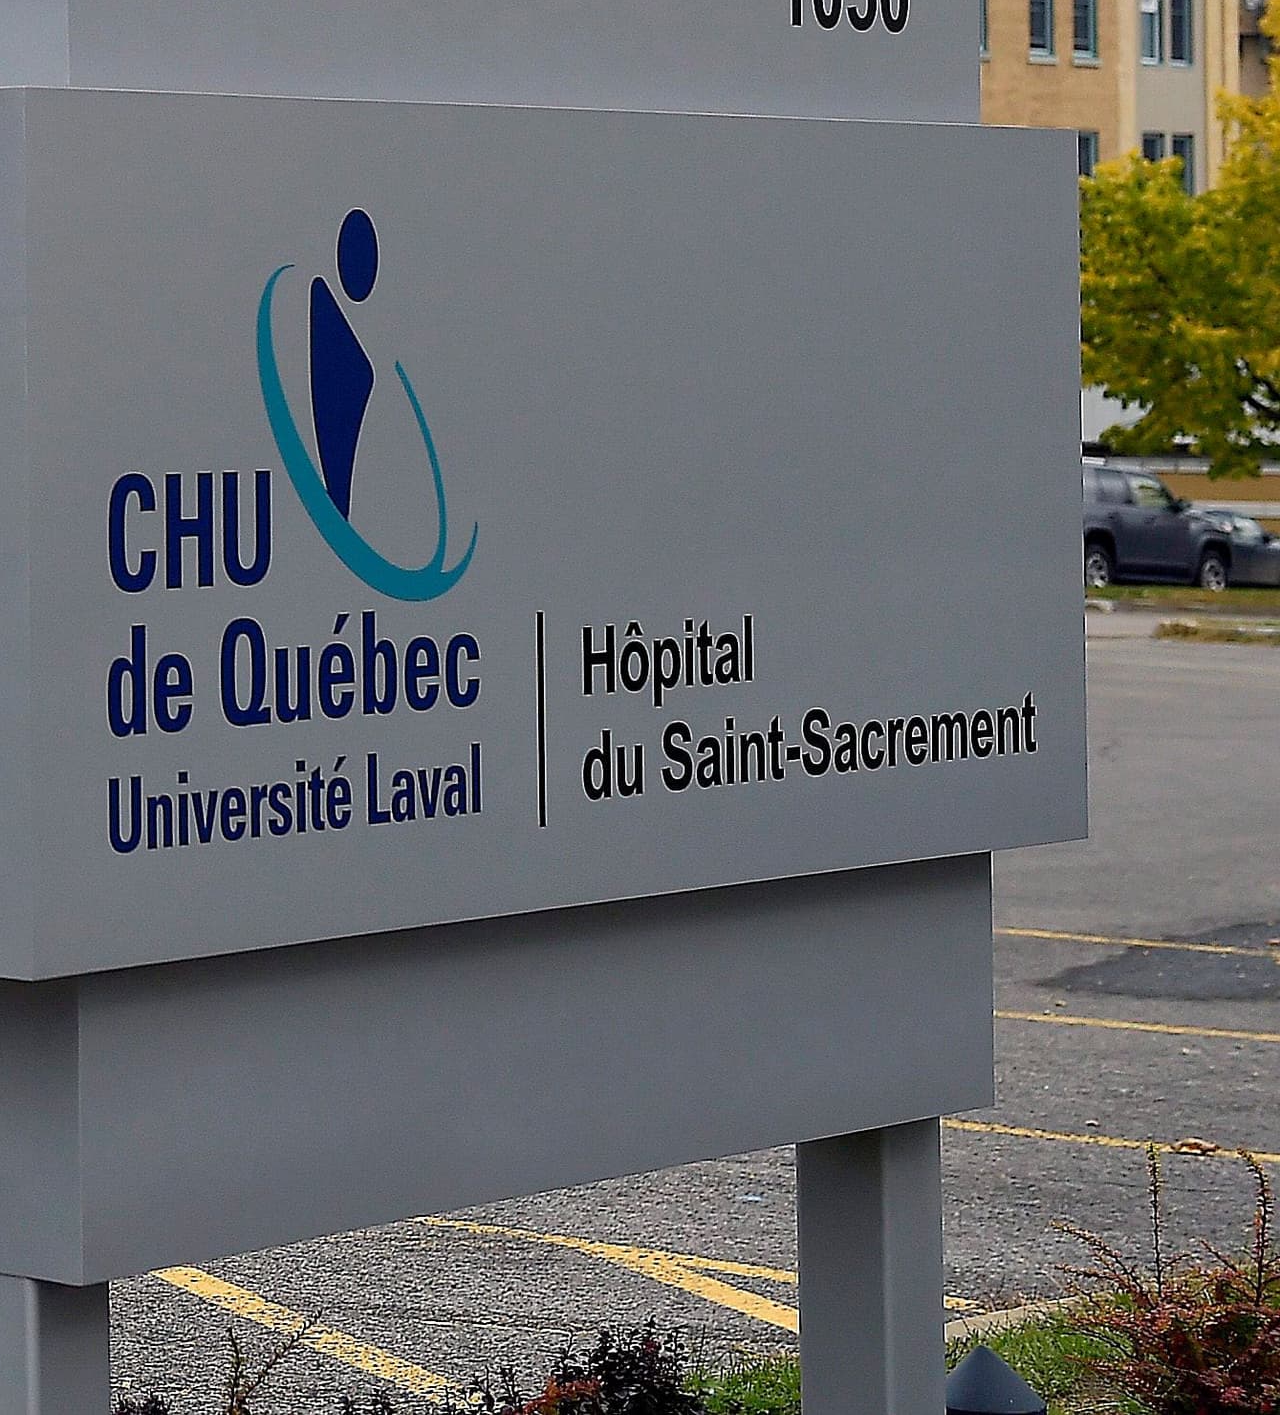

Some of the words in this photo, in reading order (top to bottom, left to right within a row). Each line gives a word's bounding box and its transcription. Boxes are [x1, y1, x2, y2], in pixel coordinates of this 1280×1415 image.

[107, 470, 271, 593] CHU
[107, 624, 193, 738] de
[220, 610, 480, 727] Québec
[582, 615, 753, 708] Hôpital
[108, 755, 352, 854] Université
[366, 742, 482, 825] Laval
[582, 729, 644, 801] du
[661, 691, 1038, 791] Saint-Sacrement
